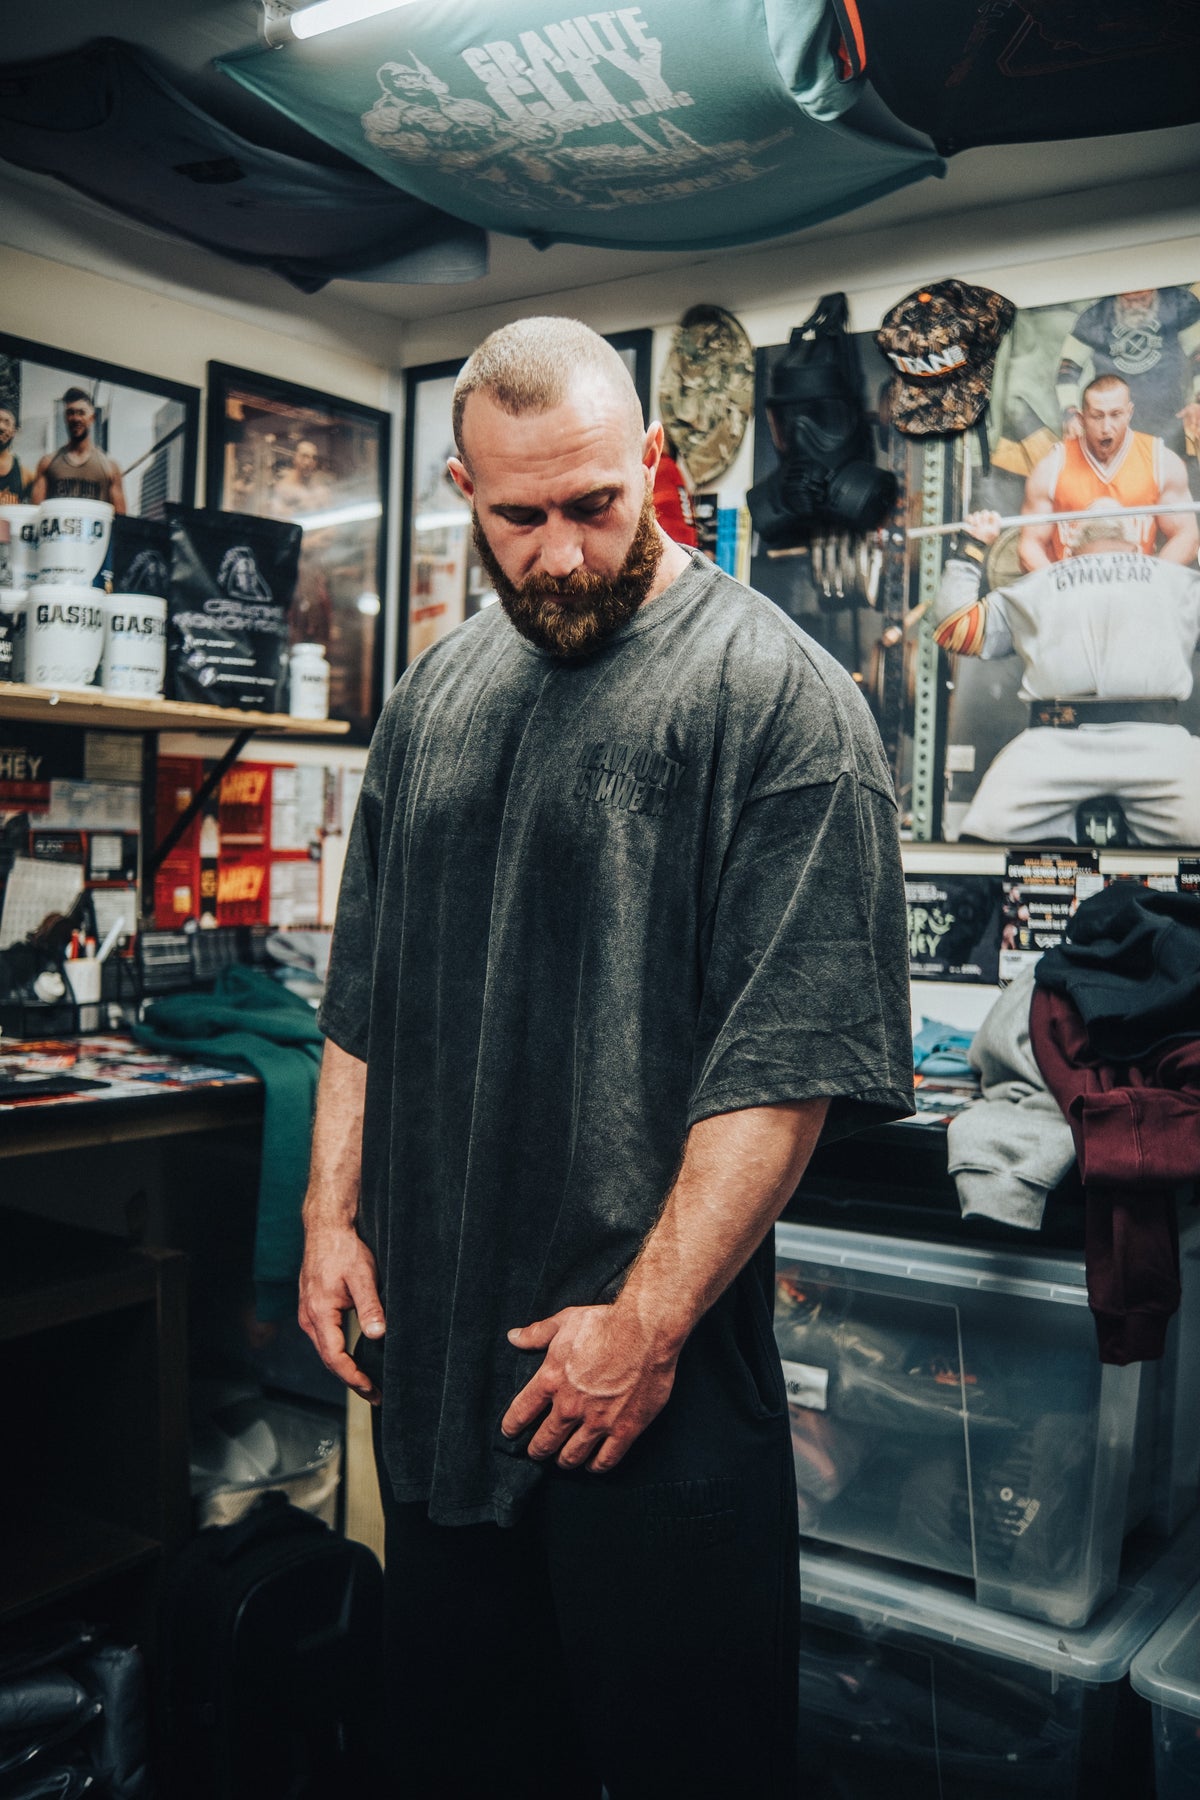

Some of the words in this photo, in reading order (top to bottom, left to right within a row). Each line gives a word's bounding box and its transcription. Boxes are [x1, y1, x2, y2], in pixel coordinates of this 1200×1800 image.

[461, 6, 659, 82] GRANITE
[485, 37, 672, 123] CITY
[1056, 565, 1153, 591] GYMWEAR
[36, 604, 80, 626] GAS
[112, 614, 153, 635] GAS
